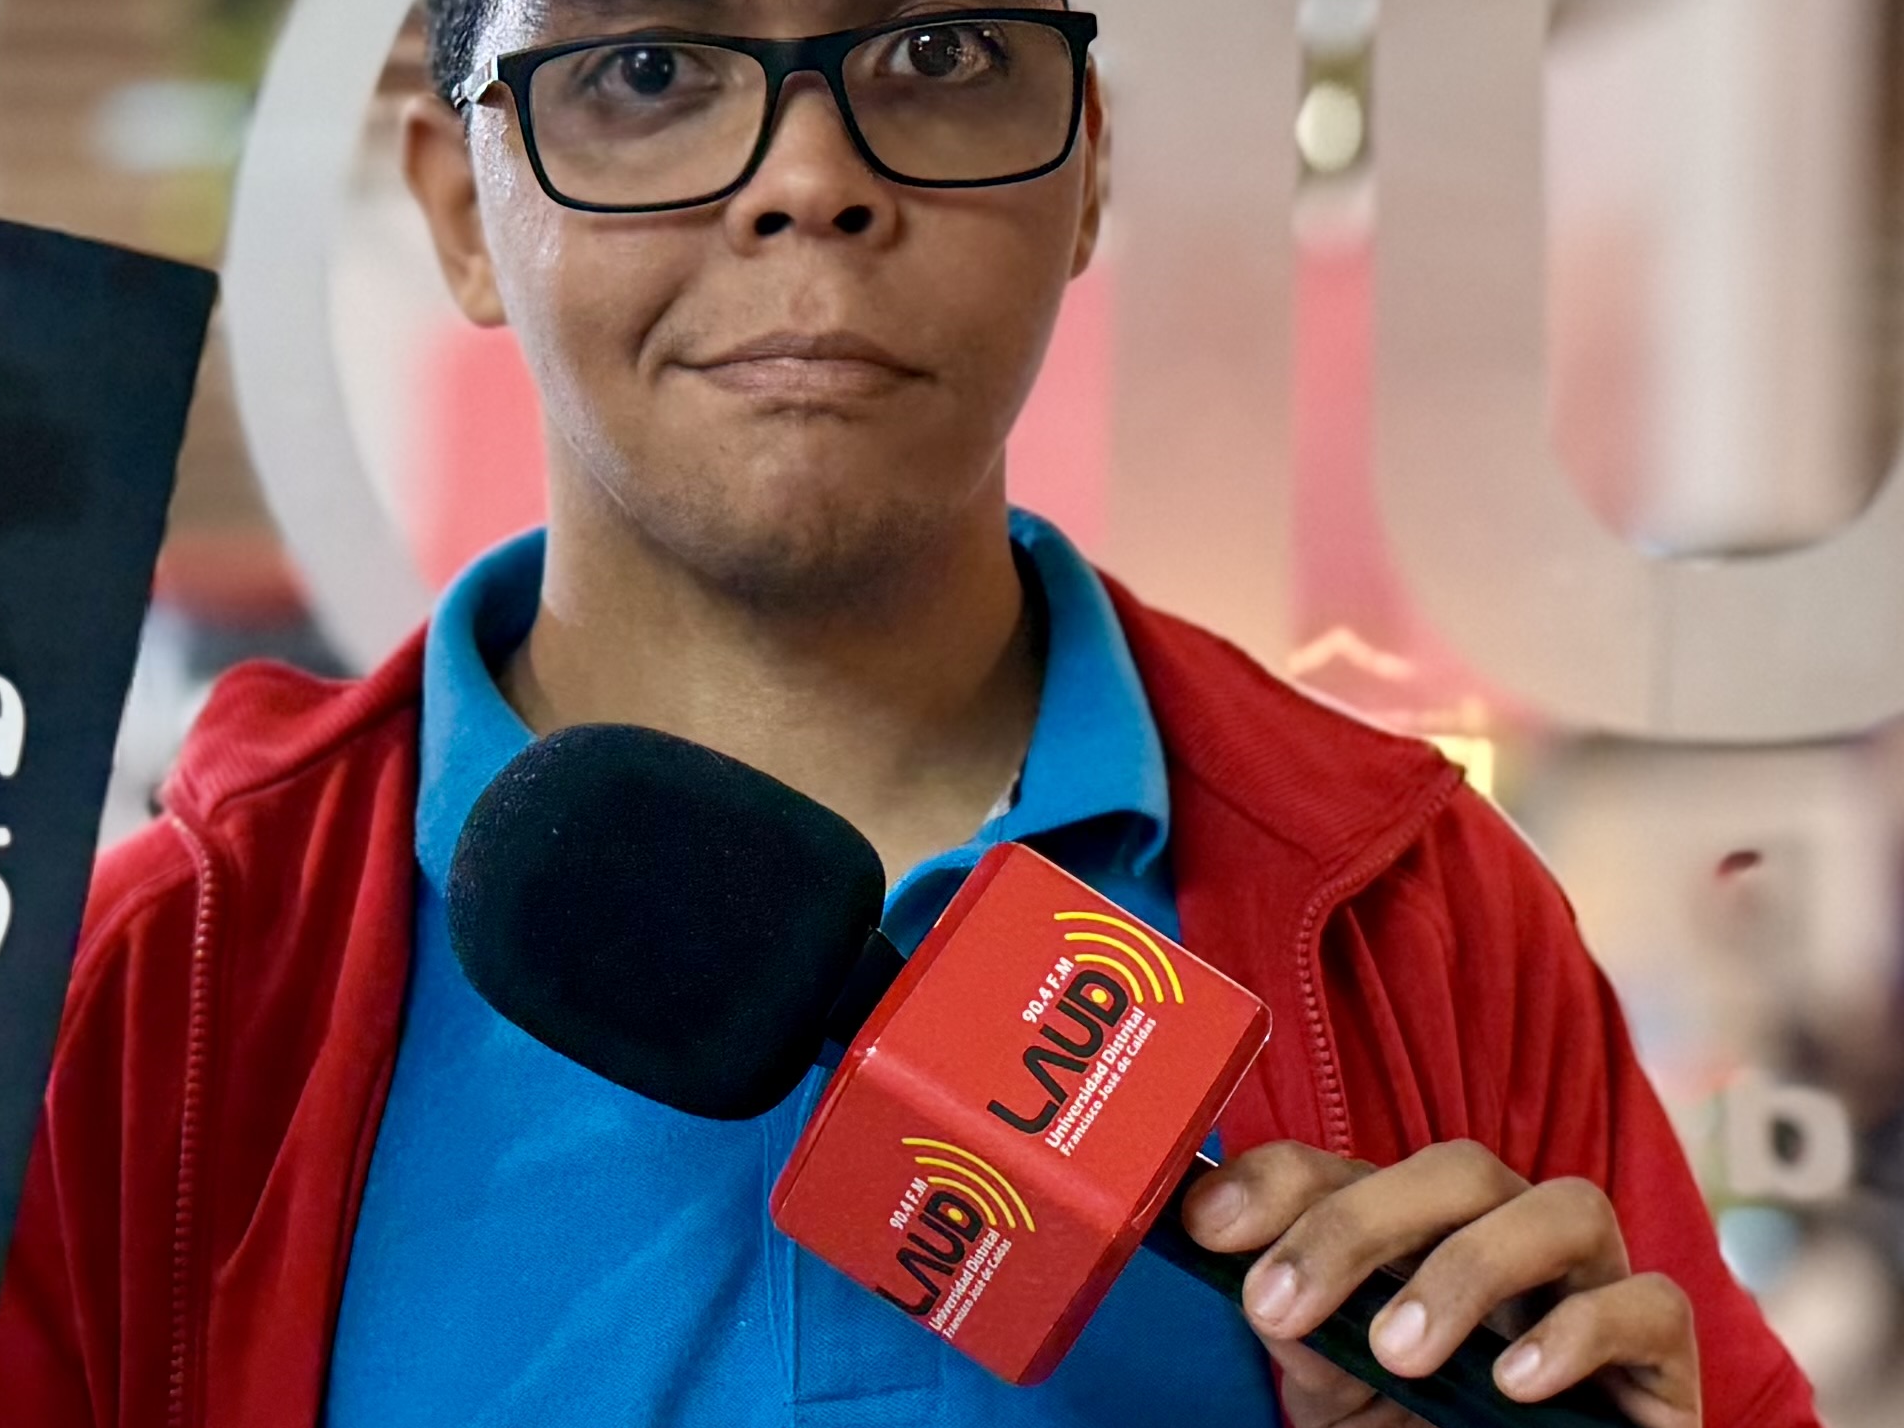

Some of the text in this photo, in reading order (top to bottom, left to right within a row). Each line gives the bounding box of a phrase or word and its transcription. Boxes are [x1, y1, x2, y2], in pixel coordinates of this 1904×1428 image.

[987, 969, 1129, 1134] LAUD
[1022, 956, 1075, 1023] 90.4 F.M
[1044, 1006, 1146, 1149] Universidad Distrital
[1059, 1017, 1157, 1157] Francisco José de Caldas
[875, 1190, 984, 1316] LAUD
[889, 1199, 915, 1230] 90.4
[928, 1227, 1001, 1331] Universidad Distrital
